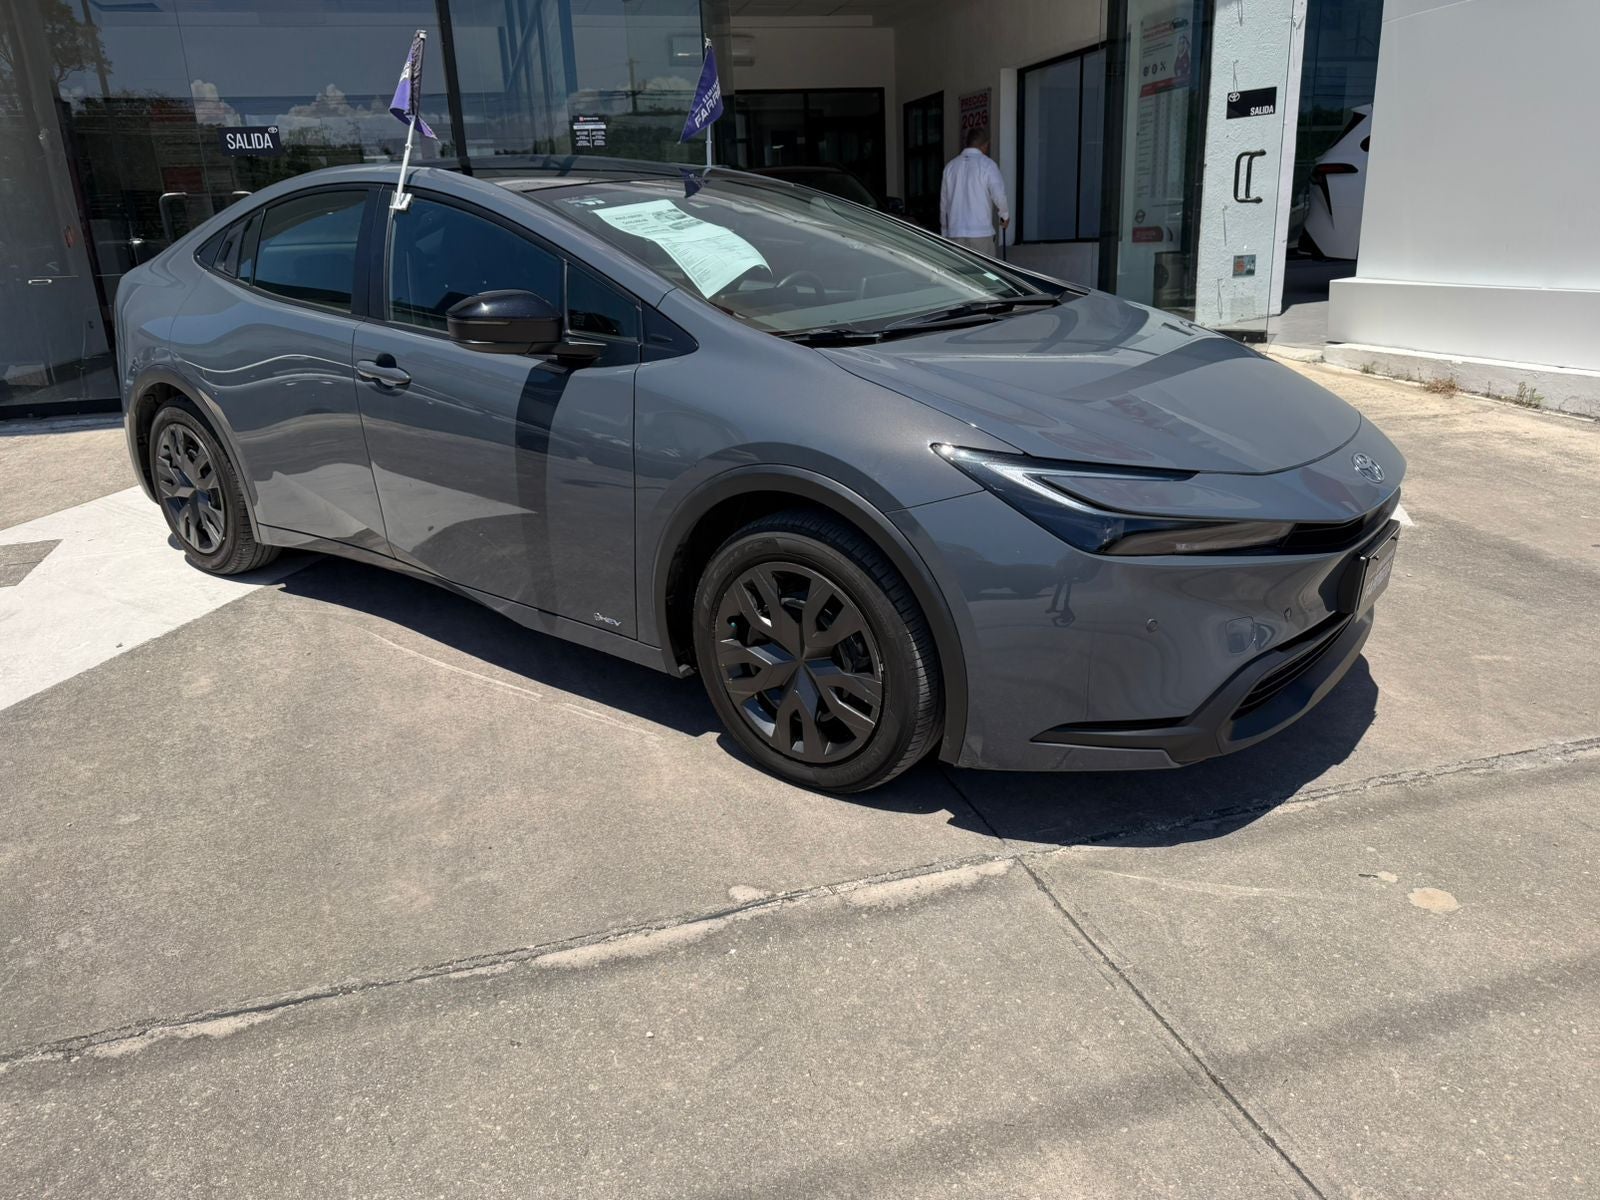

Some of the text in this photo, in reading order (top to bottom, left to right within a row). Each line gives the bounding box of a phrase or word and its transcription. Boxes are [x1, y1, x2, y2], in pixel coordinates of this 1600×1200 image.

[1250, 104, 1274, 116] SALIDA
[961, 110, 988, 129] 2026
[226, 132, 273, 150] SALIDA
